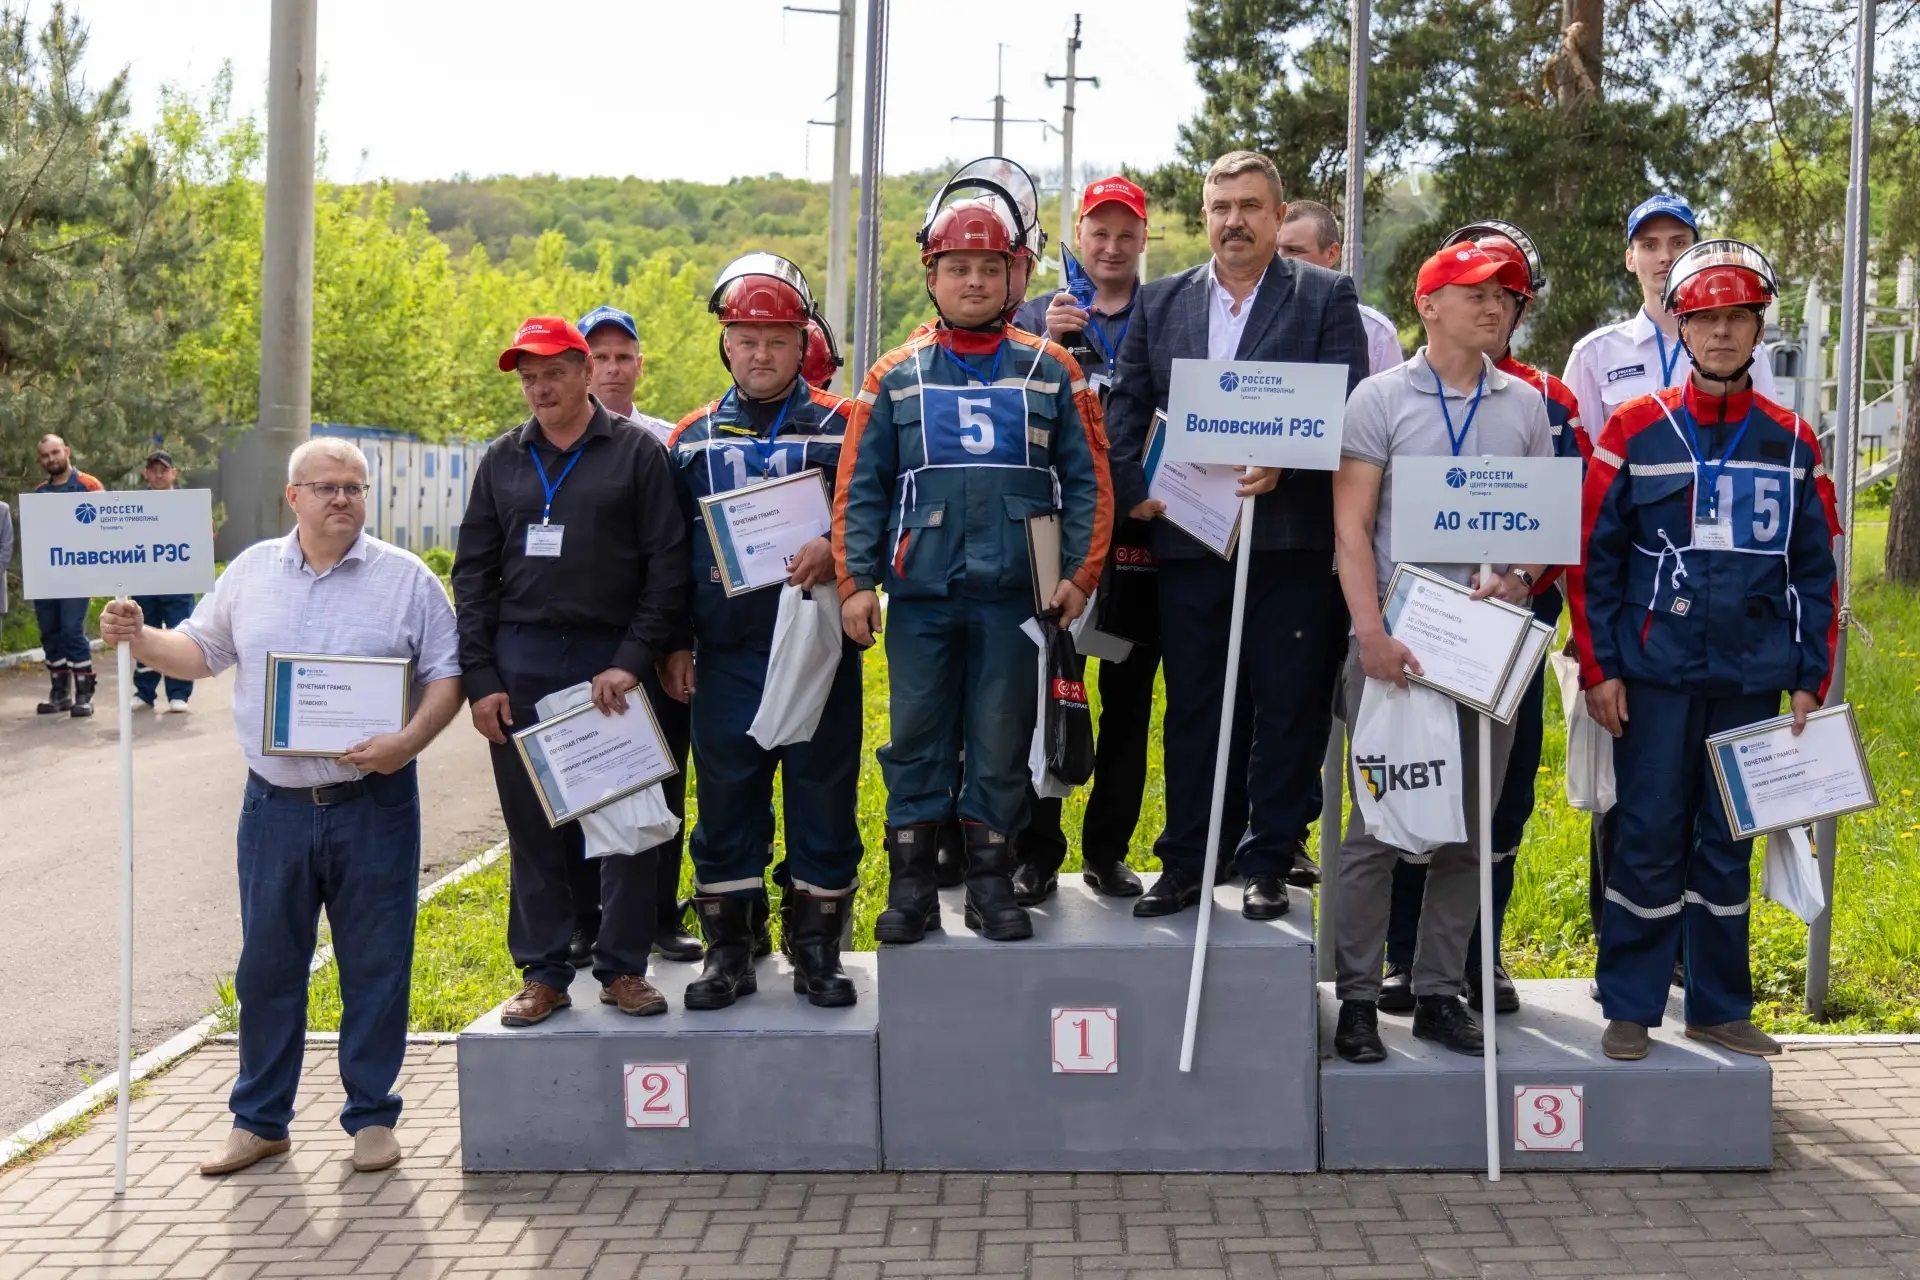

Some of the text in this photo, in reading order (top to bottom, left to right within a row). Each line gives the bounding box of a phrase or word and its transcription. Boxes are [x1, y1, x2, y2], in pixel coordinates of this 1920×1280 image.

[1242, 376, 1282, 384] РОССЕТИ
[958, 396, 995, 455] 5
[1186, 414, 1325, 438] Воловский РЭС
[1470, 471, 1513, 480] РОССЕТИ
[100, 505, 144, 514] РОССЕТИ
[732, 509, 780, 526] ПОЧЕТНАЯ ГРАМОТА
[1715, 475, 1780, 542] 15
[1434, 511, 1540, 531] АО «ТГЭС»
[50, 543, 190, 566] Плавский РЭС
[1411, 600, 1438, 614] ПОЧЕТНАЯ
[1439, 610, 1462, 624] ГРАМОТА
[549, 740, 576, 756] ПОЧЕТНАЯ
[576, 730, 599, 744] ГРАМОТА
[1744, 755, 1772, 768] ПОЧЕТНАЯ
[1773, 748, 1799, 760] ГРАМОТА
[1072, 1018, 1094, 1059] 1
[642, 1073, 672, 1113] 2
[1532, 1094, 1565, 1138] 3
